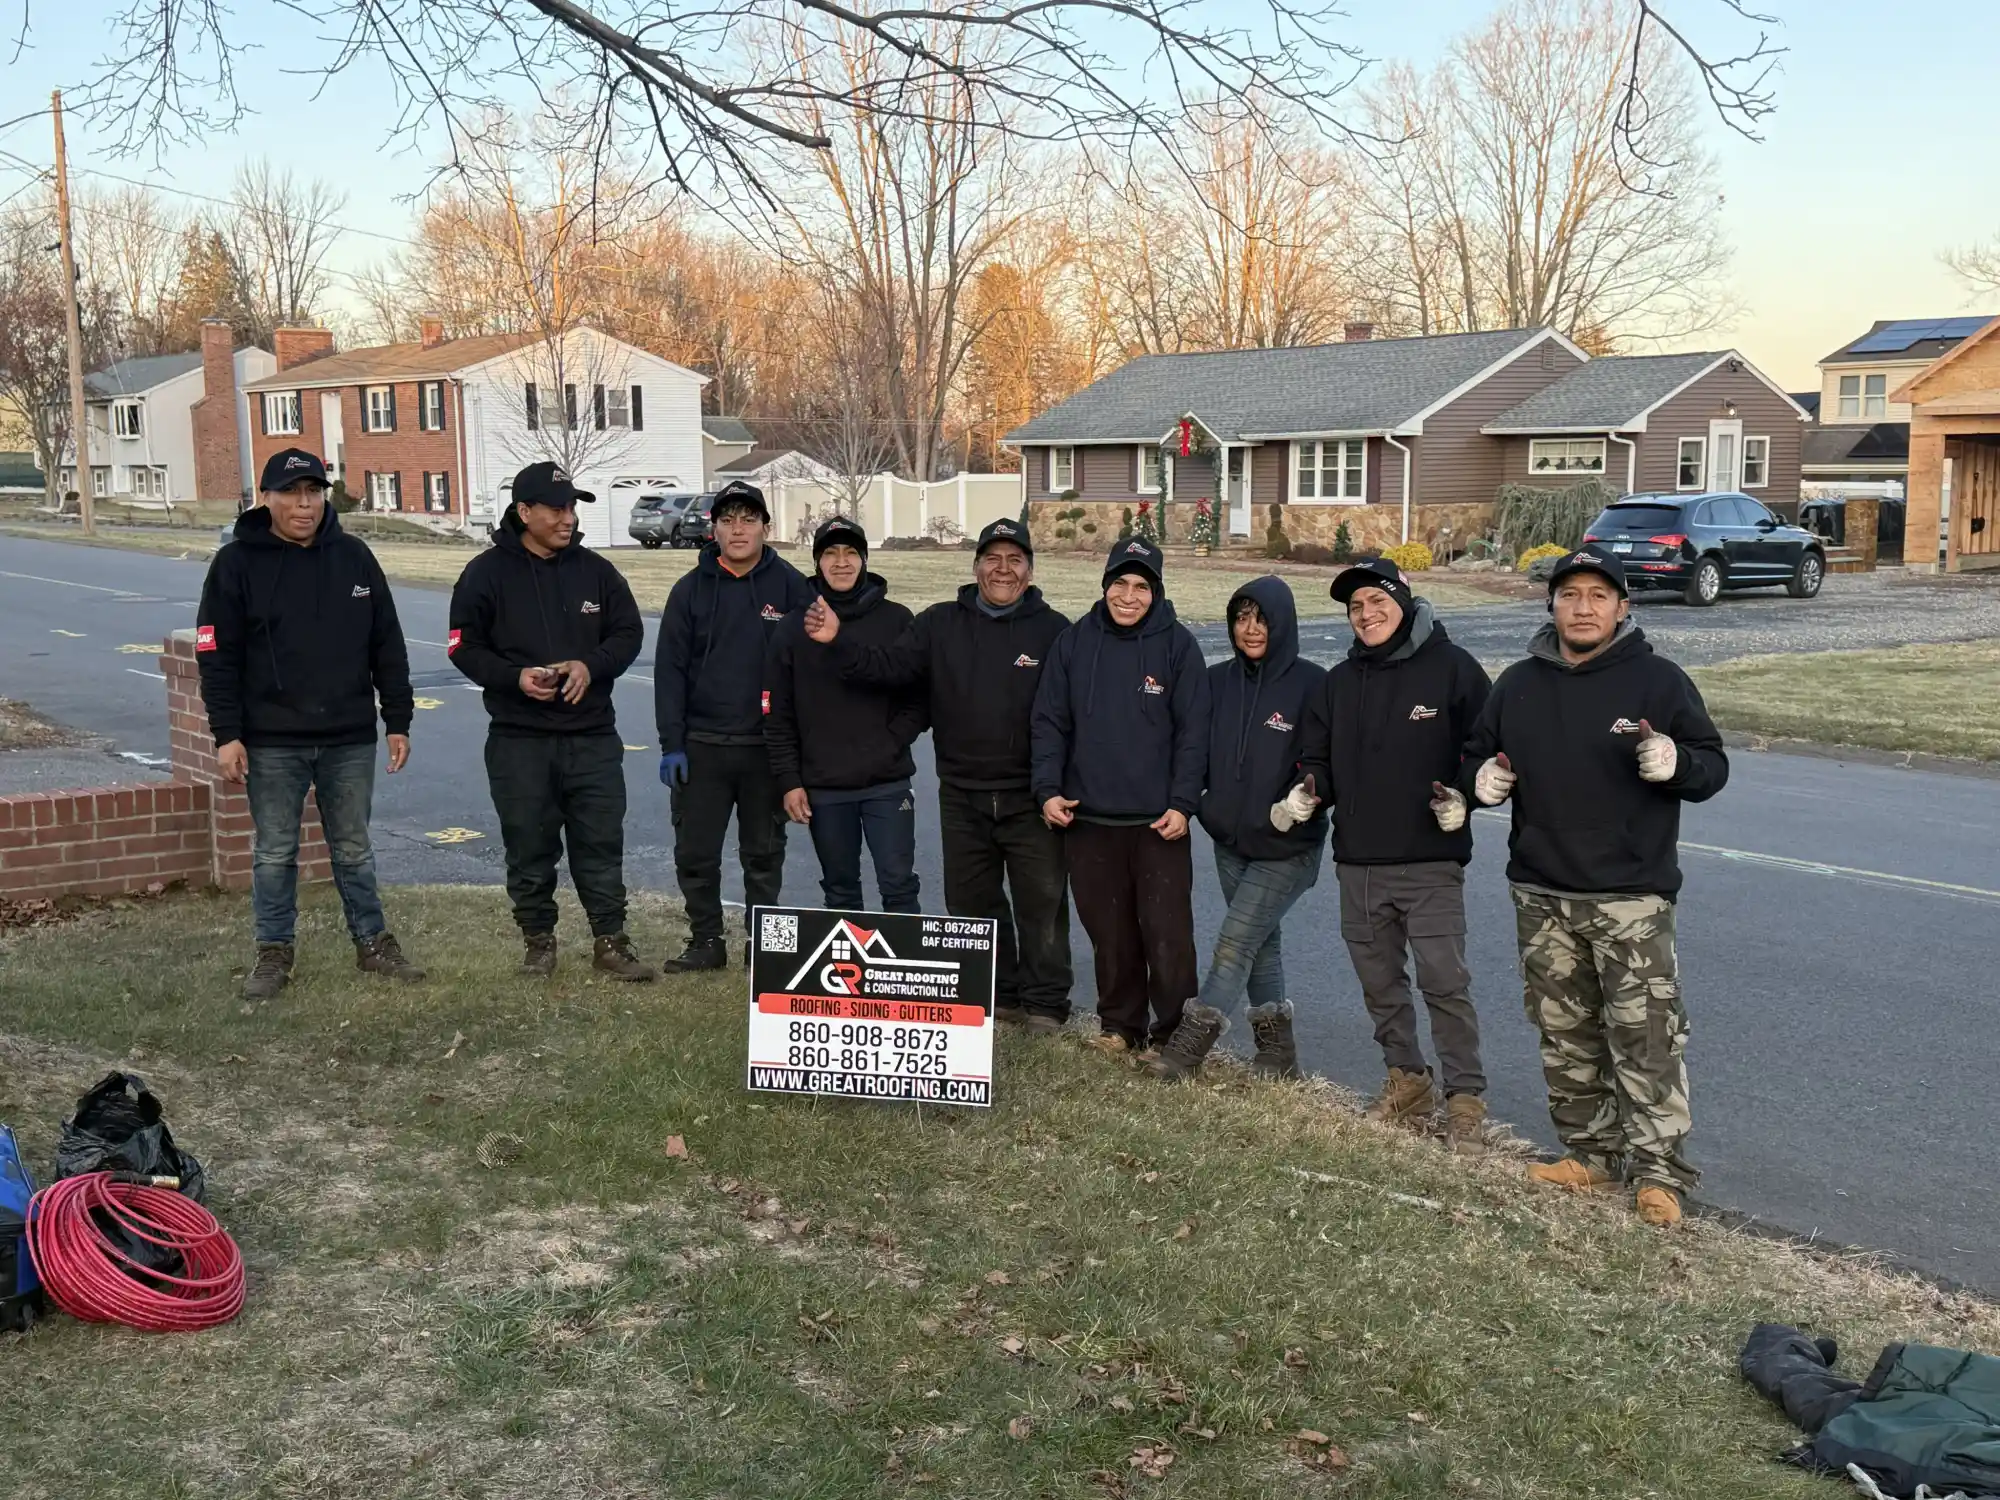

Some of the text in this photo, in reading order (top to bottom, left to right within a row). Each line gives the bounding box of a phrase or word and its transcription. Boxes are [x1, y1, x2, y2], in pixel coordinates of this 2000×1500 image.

[922, 920, 991, 935] HIC: 0672487
[922, 936, 990, 950] GAF CERTIFIED
[864, 968, 959, 985] GREAT ROOFING
[864, 983, 871, 993] &
[872, 984, 940, 998] CONSTRUCTION
[790, 998, 953, 1023] ROOFING SIDING GUTTERS
[788, 1021, 948, 1051] 860-908-8673
[788, 1045, 948, 1076] 860-861-7525
[754, 1067, 986, 1102] WWW.GREATROOFING.COM
